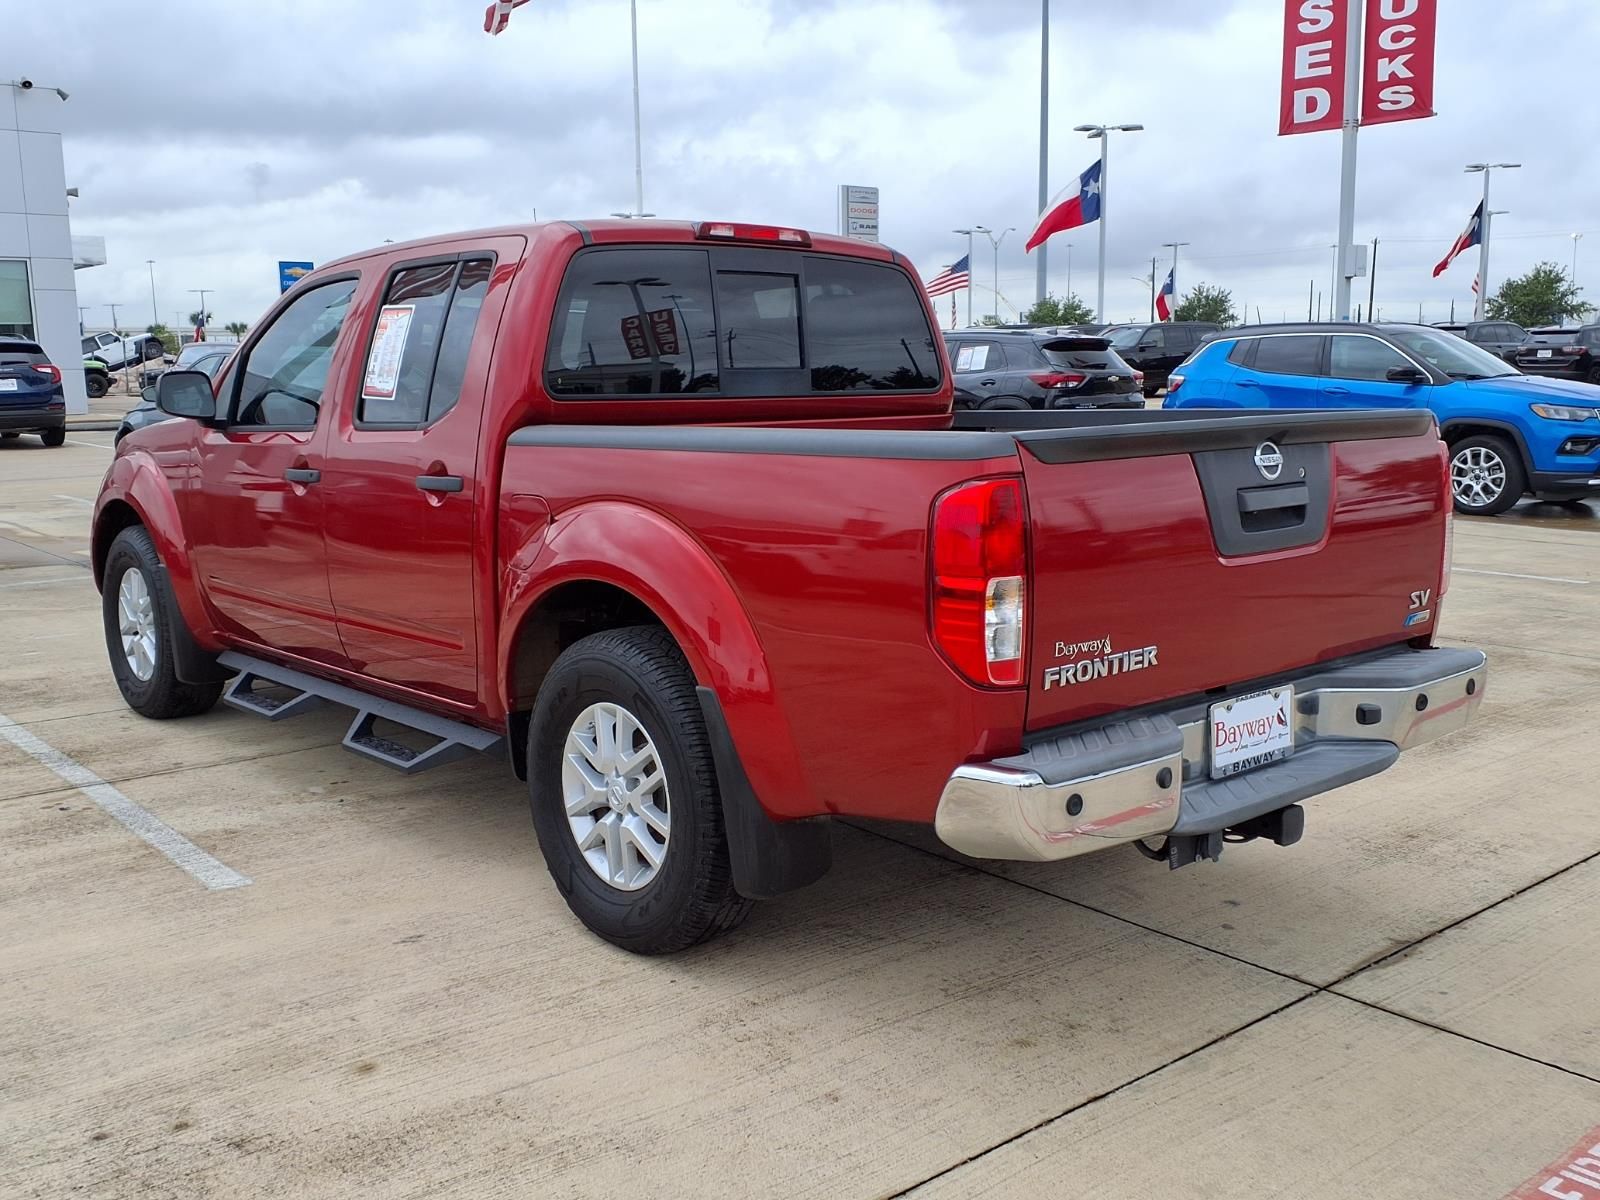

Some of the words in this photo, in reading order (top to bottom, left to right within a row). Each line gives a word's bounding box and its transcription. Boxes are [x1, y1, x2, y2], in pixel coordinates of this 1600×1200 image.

[1408, 588, 1431, 610] SV
[1055, 639, 1105, 660] Bayway
[1043, 645, 1159, 691] FRONTIER
[1214, 715, 1275, 753] Bayway
[1232, 750, 1276, 773] BAYWAY
